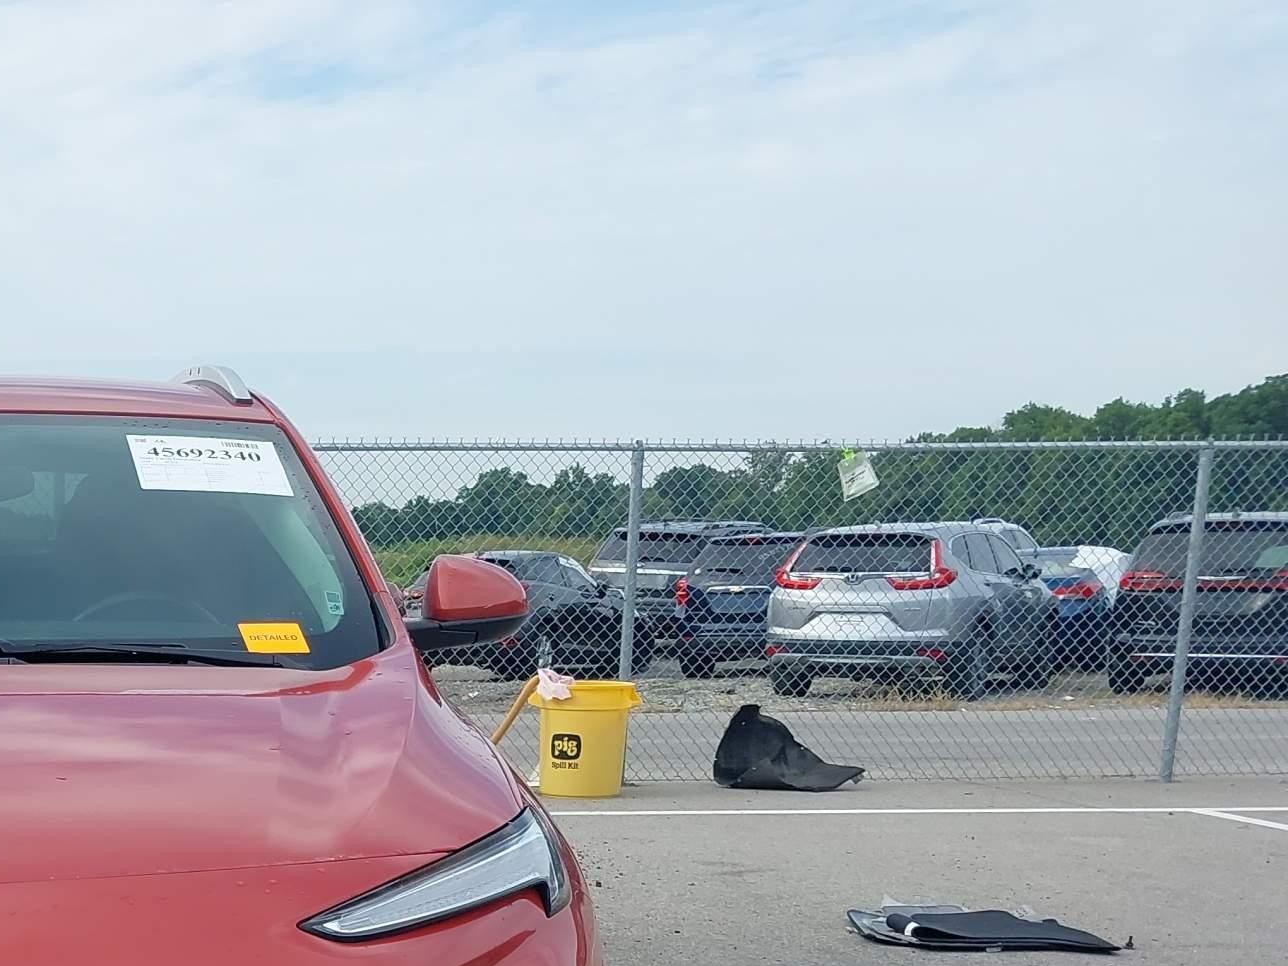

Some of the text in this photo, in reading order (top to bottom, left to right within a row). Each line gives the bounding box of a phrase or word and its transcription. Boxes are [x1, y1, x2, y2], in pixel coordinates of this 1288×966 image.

[147, 446, 261, 463] 45692340
[249, 633, 298, 641] DETAILED
[553, 736, 578, 757] pig
[551, 761, 579, 770] Spill Kit
